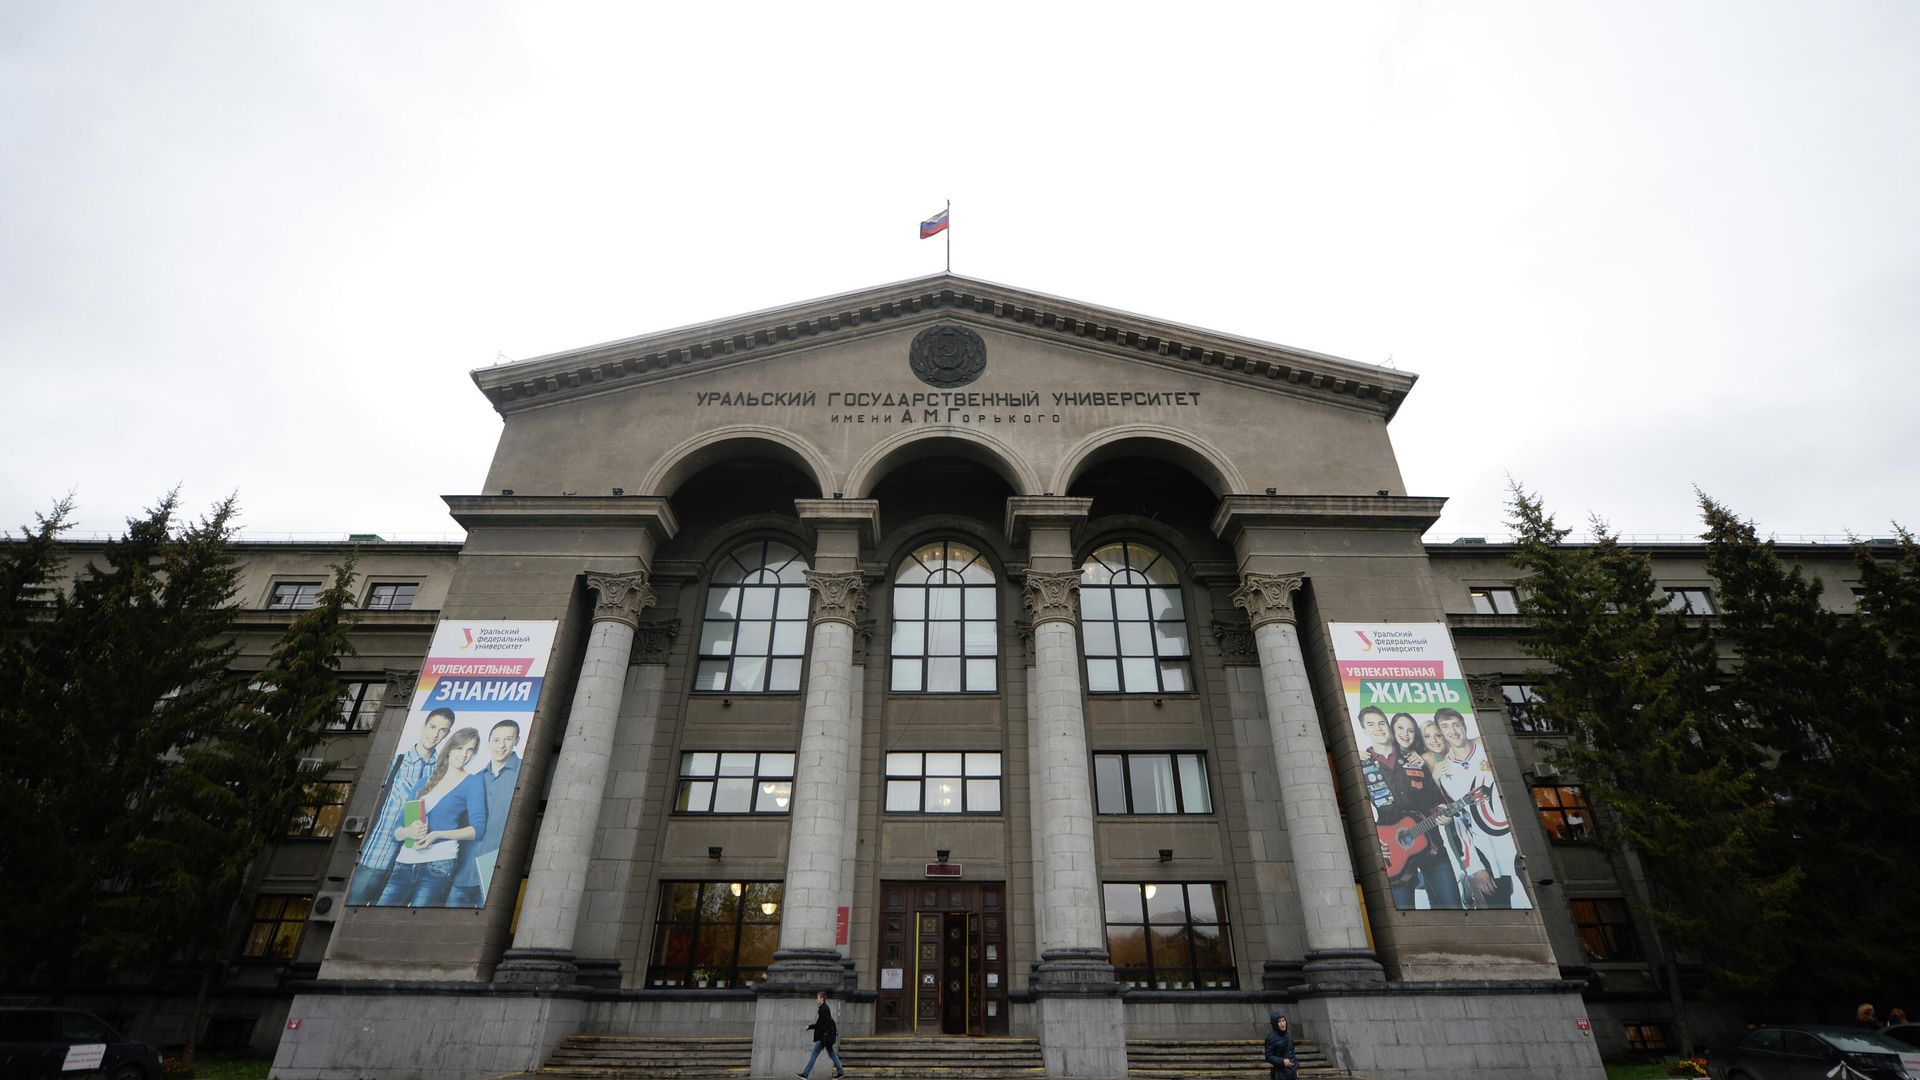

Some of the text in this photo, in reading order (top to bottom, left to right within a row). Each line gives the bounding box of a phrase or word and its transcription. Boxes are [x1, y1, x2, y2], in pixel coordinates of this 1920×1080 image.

[696, 390, 1200, 407] УРАЛЬСКИЙ ГОСУДАРСТВЕННЫЙ УНИВЕРСИТЕТ
[831, 414, 892, 423] ИМЕНИ
[479, 628, 520, 636] Уральский
[1372, 630, 1413, 638] Уральский
[476, 635, 531, 644] федеральный
[1374, 637, 1428, 646] федеральный
[474, 643, 523, 651] университет
[1376, 645, 1425, 653] университет
[430, 664, 523, 675] УВЛЕКАТЕЛЬНЫЕ
[1345, 667, 1436, 677] УВЛЕКАТЕЛЬНАЯ
[434, 680, 533, 702] ЗНАНИЯ
[1365, 682, 1461, 703] ЖИЗНЬ
